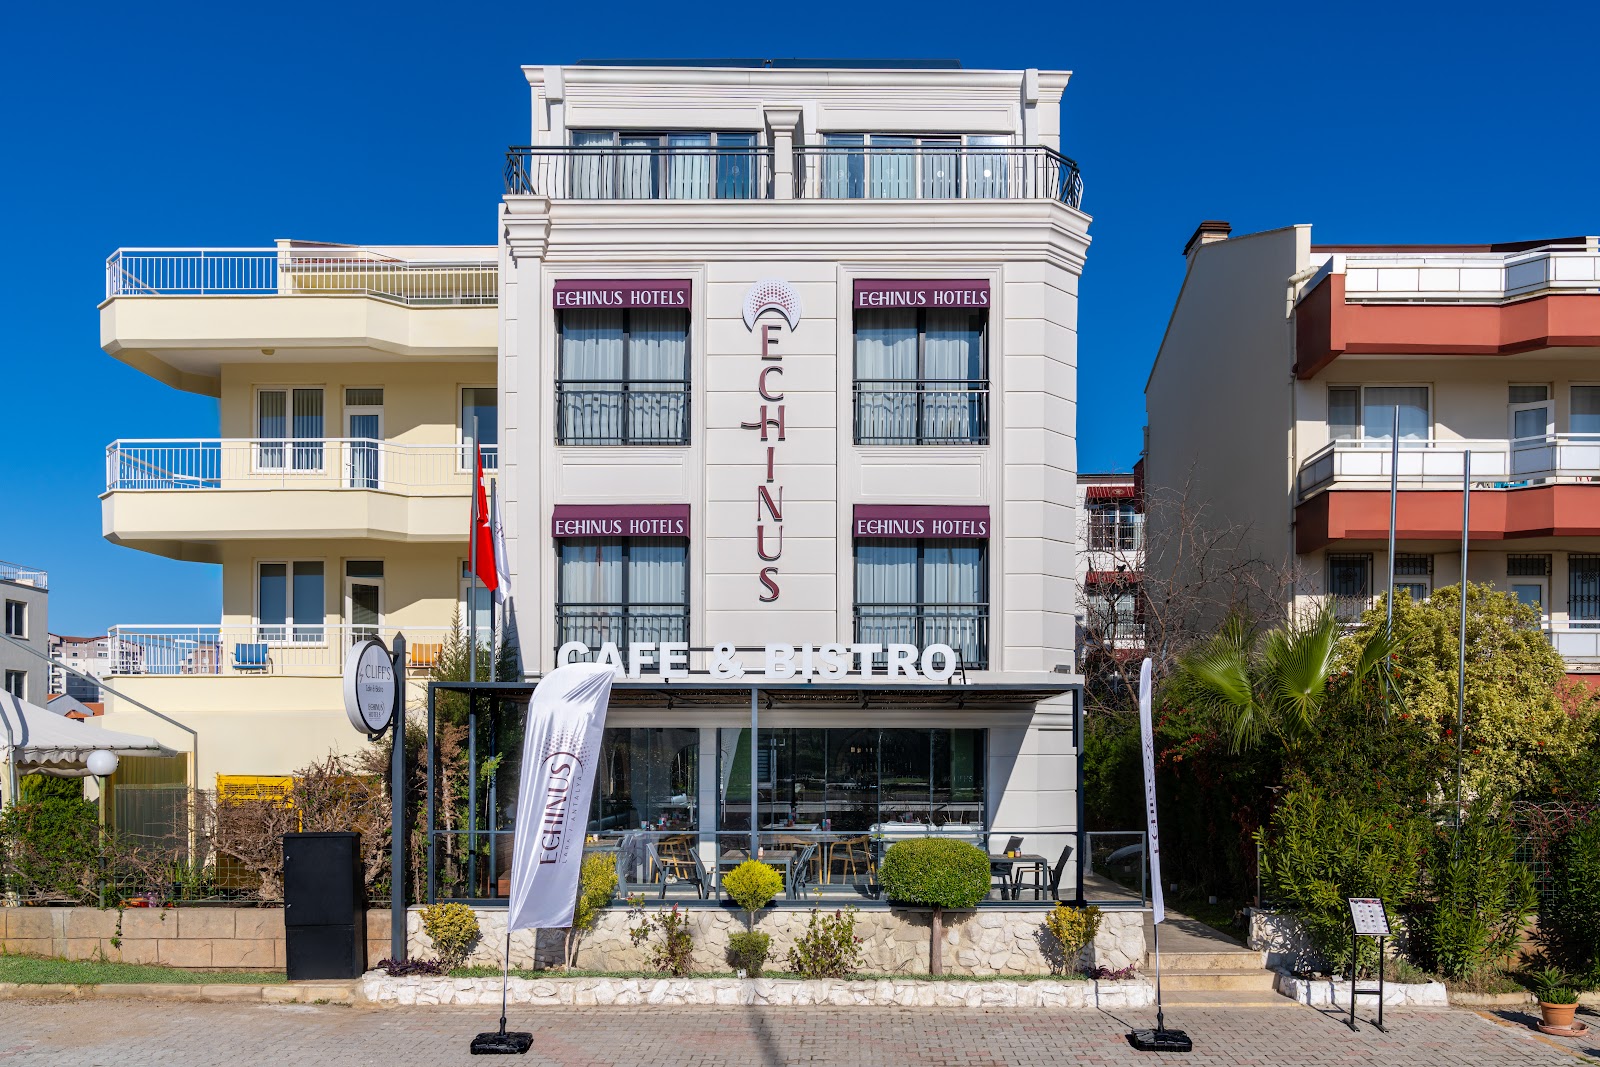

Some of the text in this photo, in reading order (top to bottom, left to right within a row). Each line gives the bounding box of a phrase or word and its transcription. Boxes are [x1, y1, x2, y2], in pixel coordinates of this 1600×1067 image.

[556, 290, 685, 306] ECHINUS HOTELS
[859, 290, 988, 306] ECHINUS HOTELS
[741, 324, 786, 603] ECHINUS
[555, 519, 684, 535] ECHINUS HOTELS
[857, 519, 987, 536] ECHINUS HOTELS
[557, 641, 957, 681] CAFE & BISTRO
[365, 664, 391, 680] CLIFF'S
[570, 776, 582, 822] ANTALYA
[540, 763, 571, 865] ECHINUS
